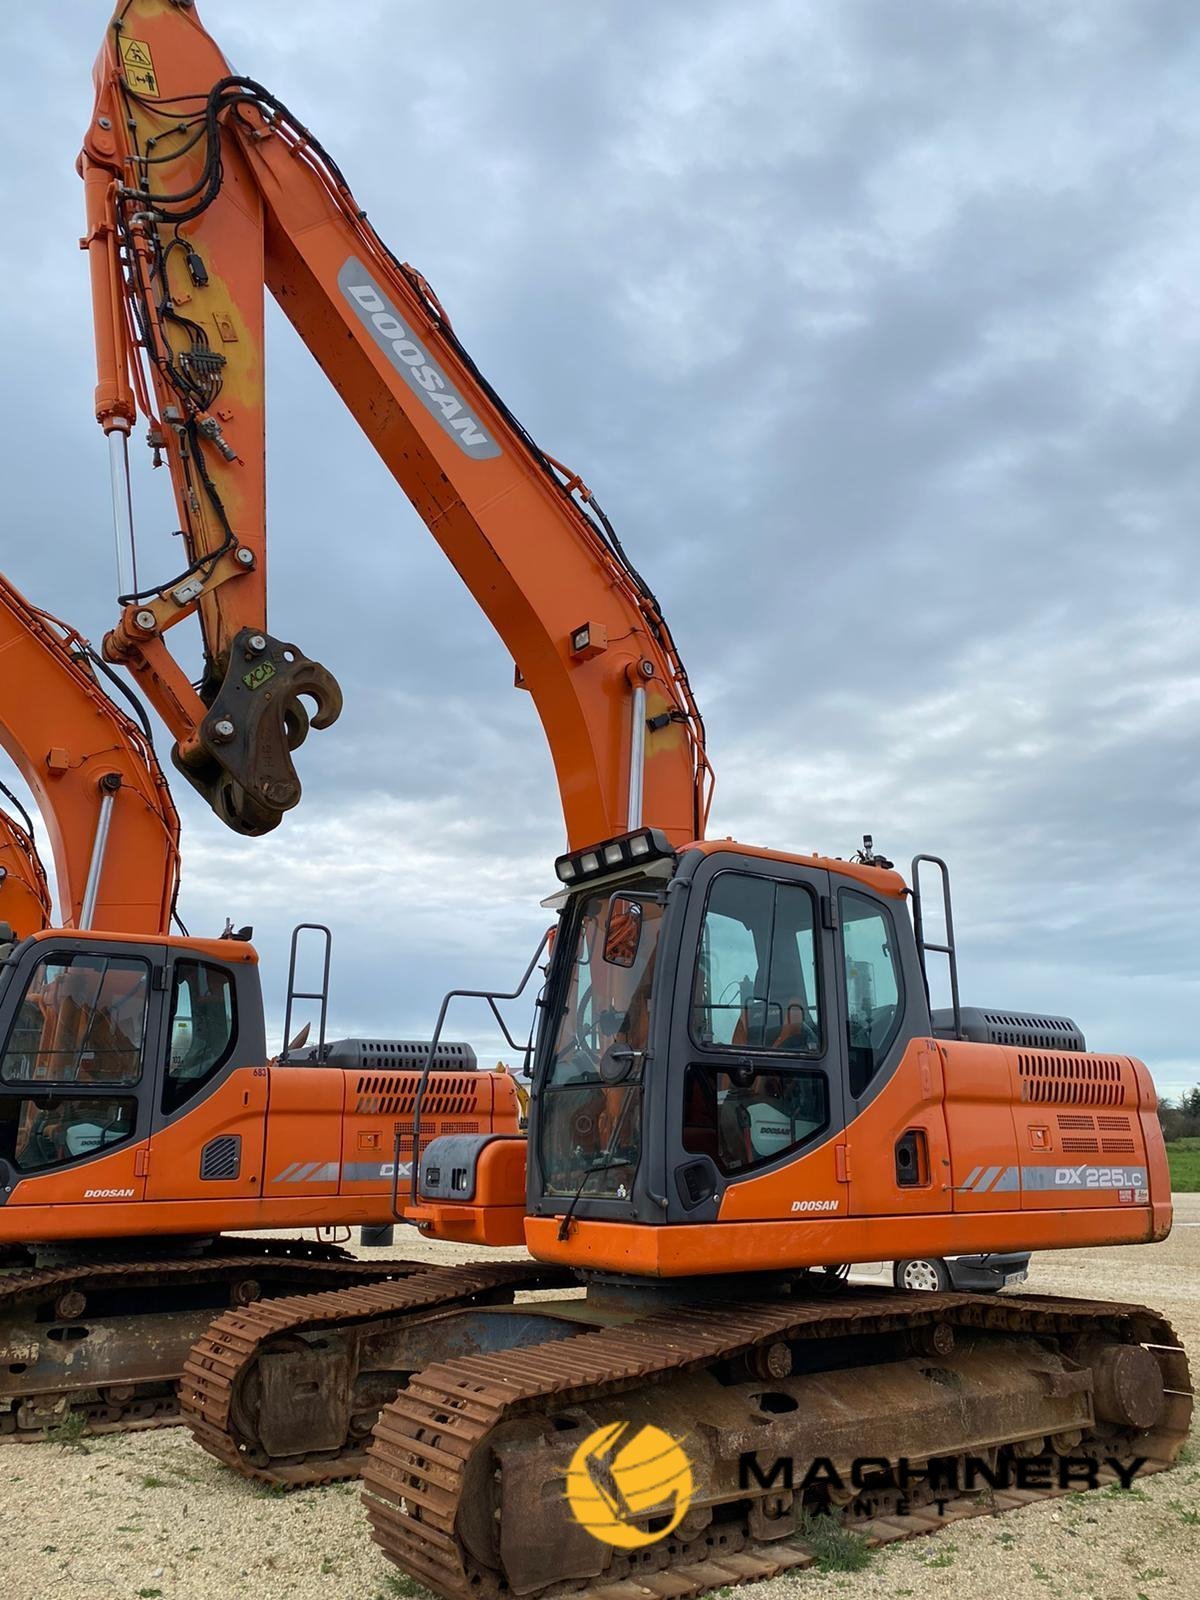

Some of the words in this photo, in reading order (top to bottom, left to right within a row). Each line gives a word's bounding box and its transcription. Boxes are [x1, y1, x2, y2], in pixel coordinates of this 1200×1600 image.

[347, 285, 488, 447] DOOSAN
[1055, 1163, 1087, 1184] DX
[84, 1188, 135, 1198] DOOSAN
[791, 1200, 839, 1212] DOOSAN
